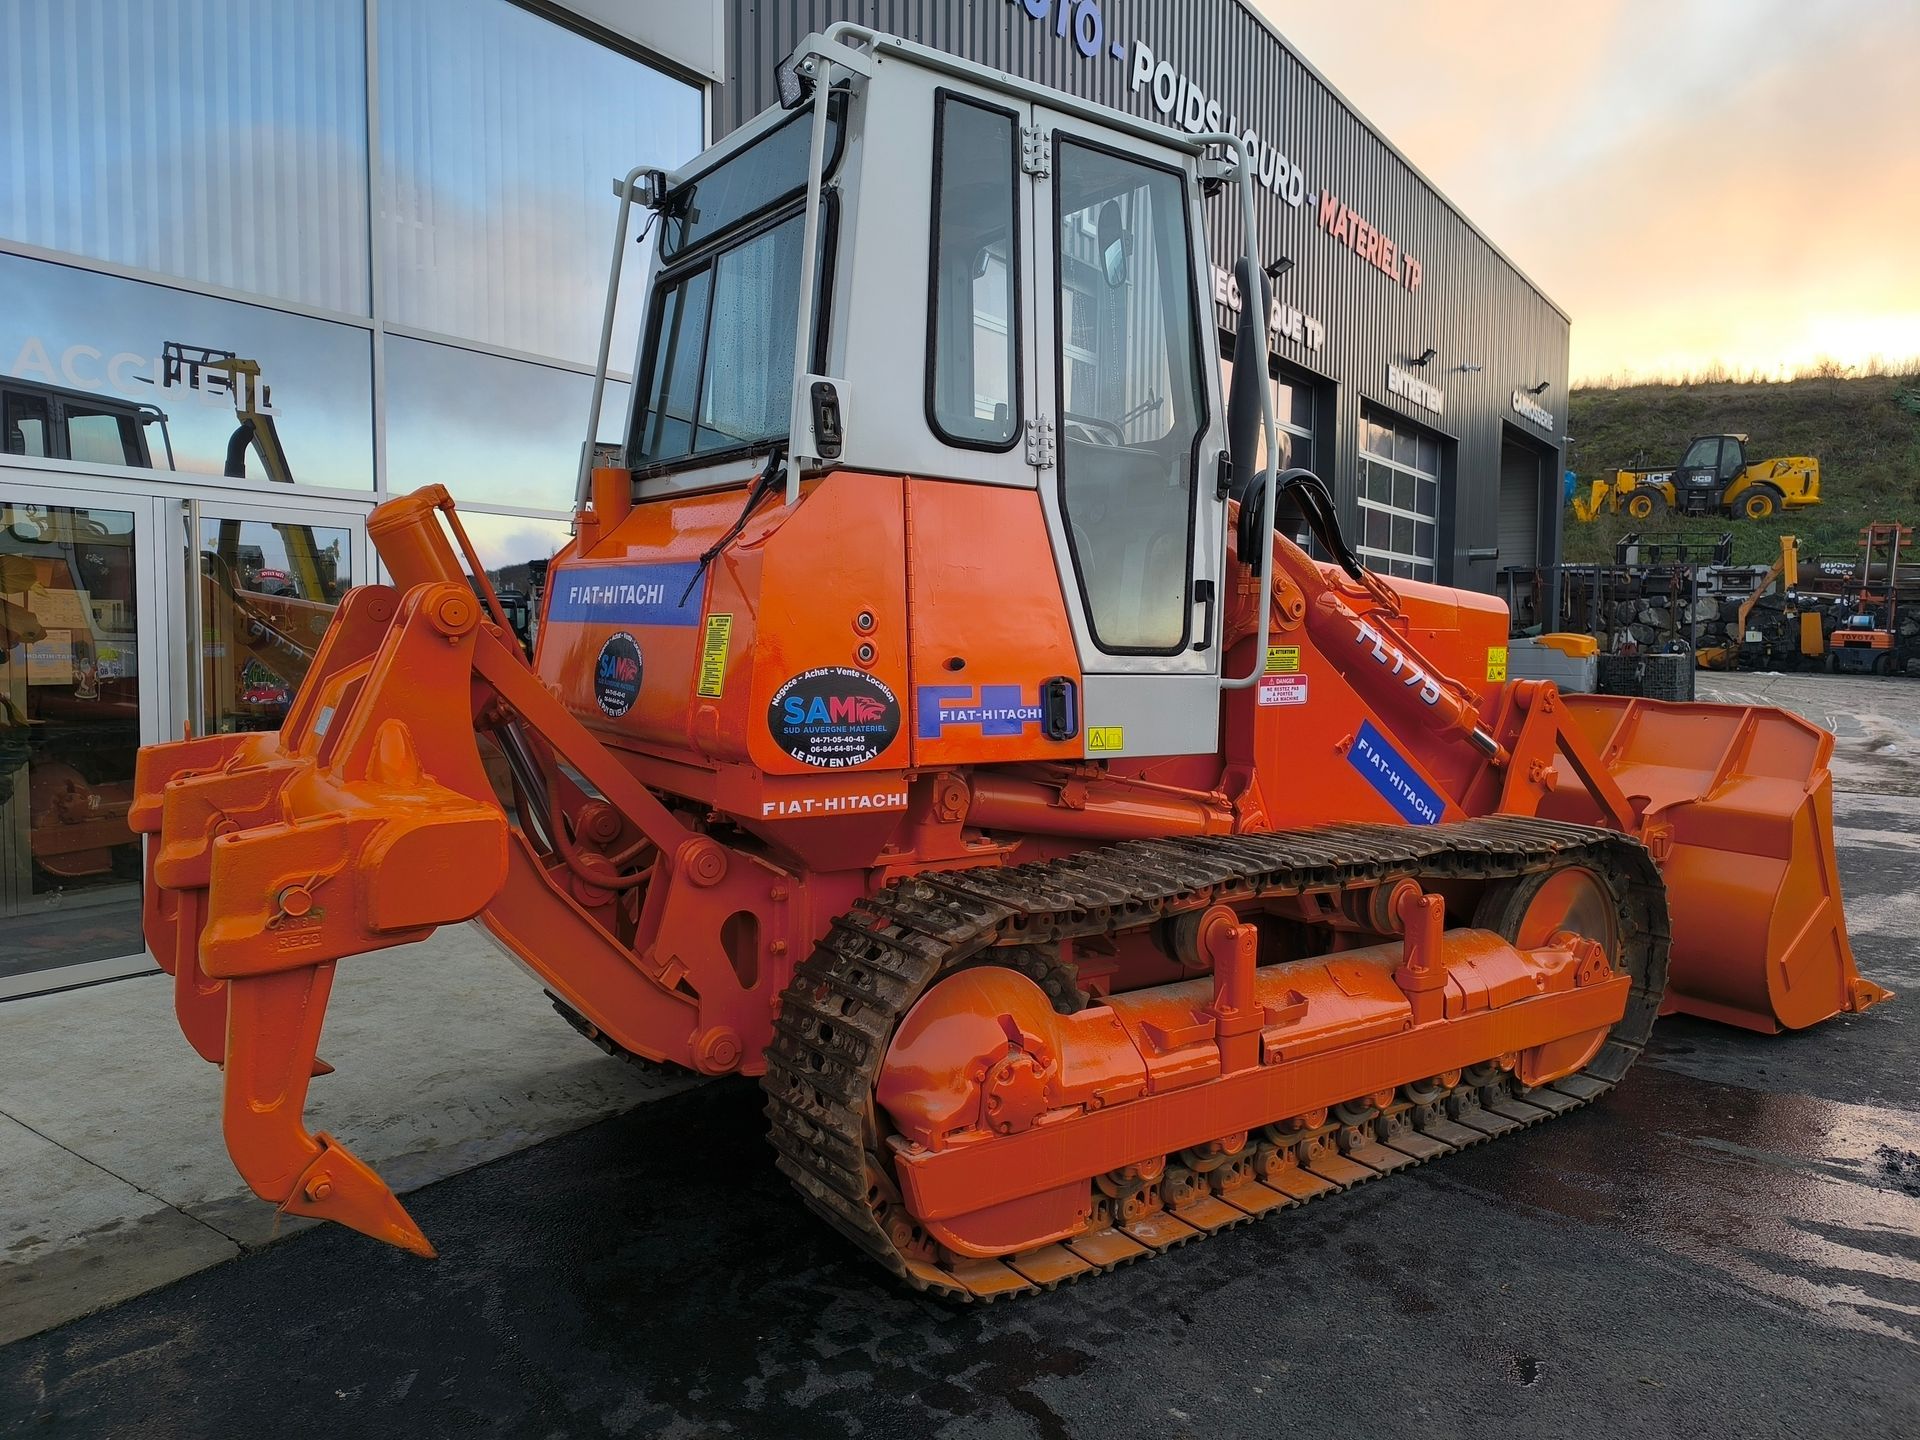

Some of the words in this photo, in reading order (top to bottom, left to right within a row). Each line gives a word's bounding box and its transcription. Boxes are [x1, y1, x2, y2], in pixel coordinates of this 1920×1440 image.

[1131, 39, 1222, 148] POIDS
[1319, 189, 1398, 282] MATERIEL
[1402, 253, 1422, 294] TP
[1303, 316, 1323, 351] TP
[10, 336, 281, 417] ACCUEIL
[1387, 362, 1443, 416] ENTRETIEN
[1692, 475, 1711, 483] JCB
[569, 584, 664, 605] FIAT-HITACHI
[1840, 633, 1875, 641] TOYOTA
[1355, 623, 1440, 705] FL175
[771, 677, 798, 707] Negoce
[804, 668, 829, 680] Achat
[836, 667, 860, 678] Vente
[865, 674, 895, 703] Location
[783, 696, 856, 725] SAM
[939, 708, 1042, 721] FIAT-HITACHI
[783, 726, 800, 734] SUD
[803, 726, 847, 734] AUVERGNE
[849, 725, 887, 733] MATERIEL
[810, 736, 865, 744] 04-71-05-40-43
[790, 747, 804, 761] LE
[806, 756, 827, 767] PUY
[829, 758, 844, 767] EN
[846, 746, 878, 766] VELAY
[810, 745, 865, 753] 06-84-64-81-40
[1357, 737, 1437, 825] FIAT-HITACHI
[763, 793, 907, 816] FIAT-HITACHI
